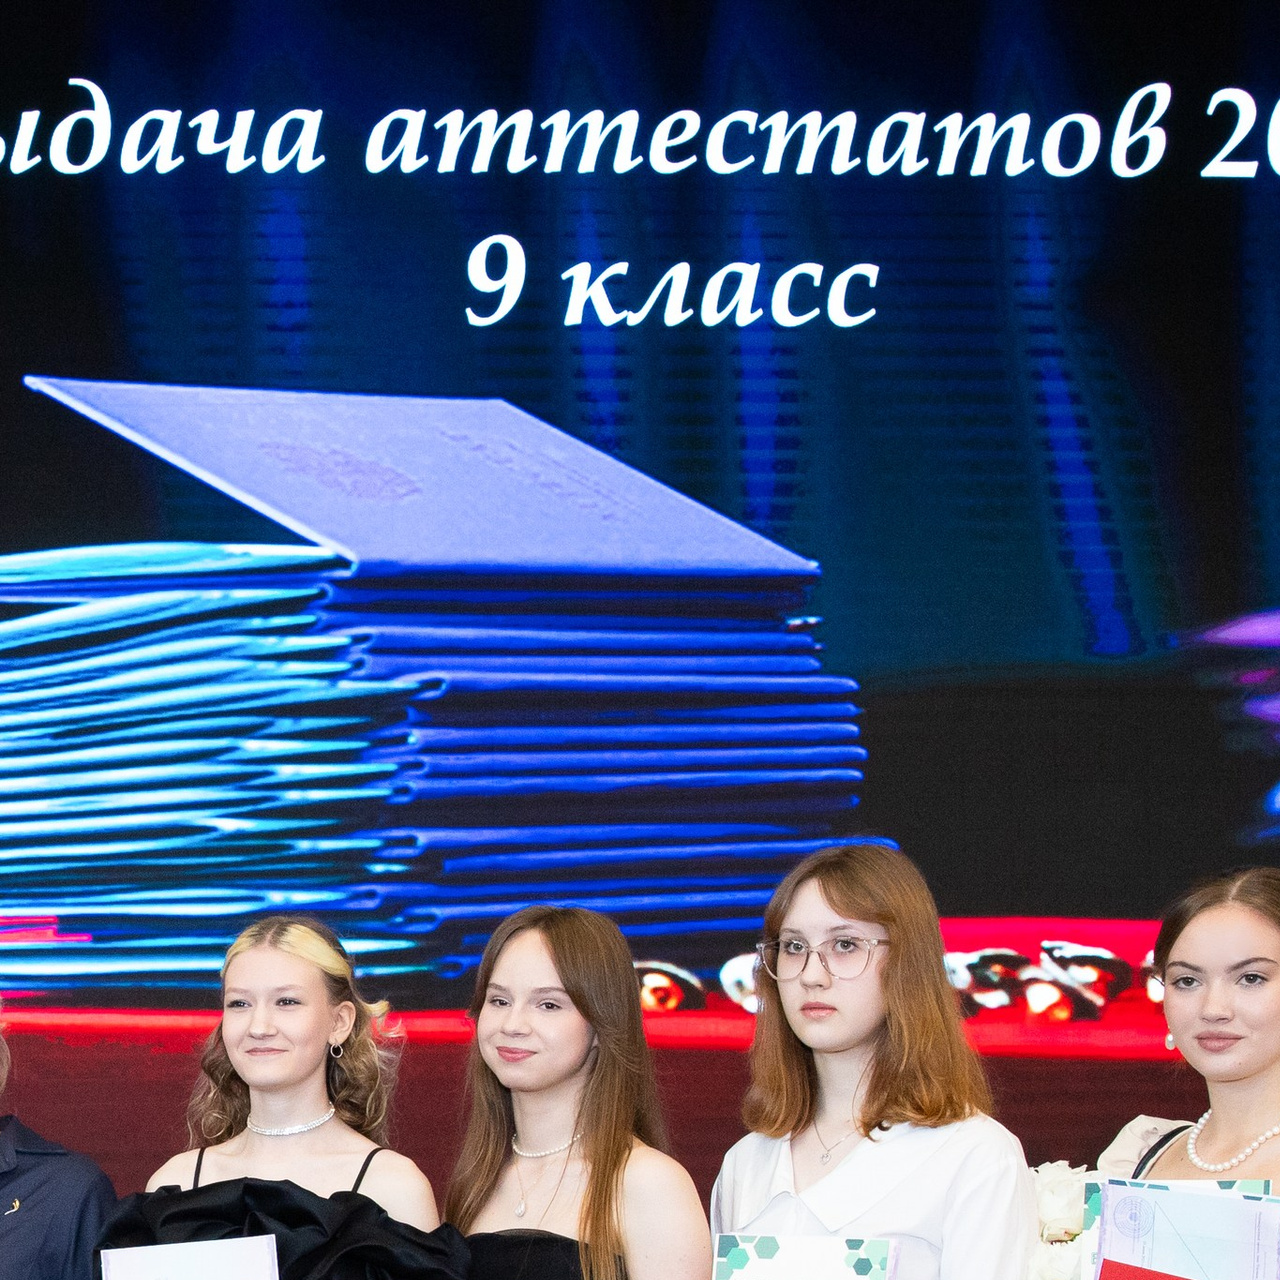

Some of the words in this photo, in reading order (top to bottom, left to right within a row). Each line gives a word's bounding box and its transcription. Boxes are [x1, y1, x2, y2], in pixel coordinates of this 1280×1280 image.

[366, 83, 1171, 177] аттестатов
[1201, 88, 1280, 177] 2
[466, 234, 525, 326] 9
[562, 262, 879, 327] класс
